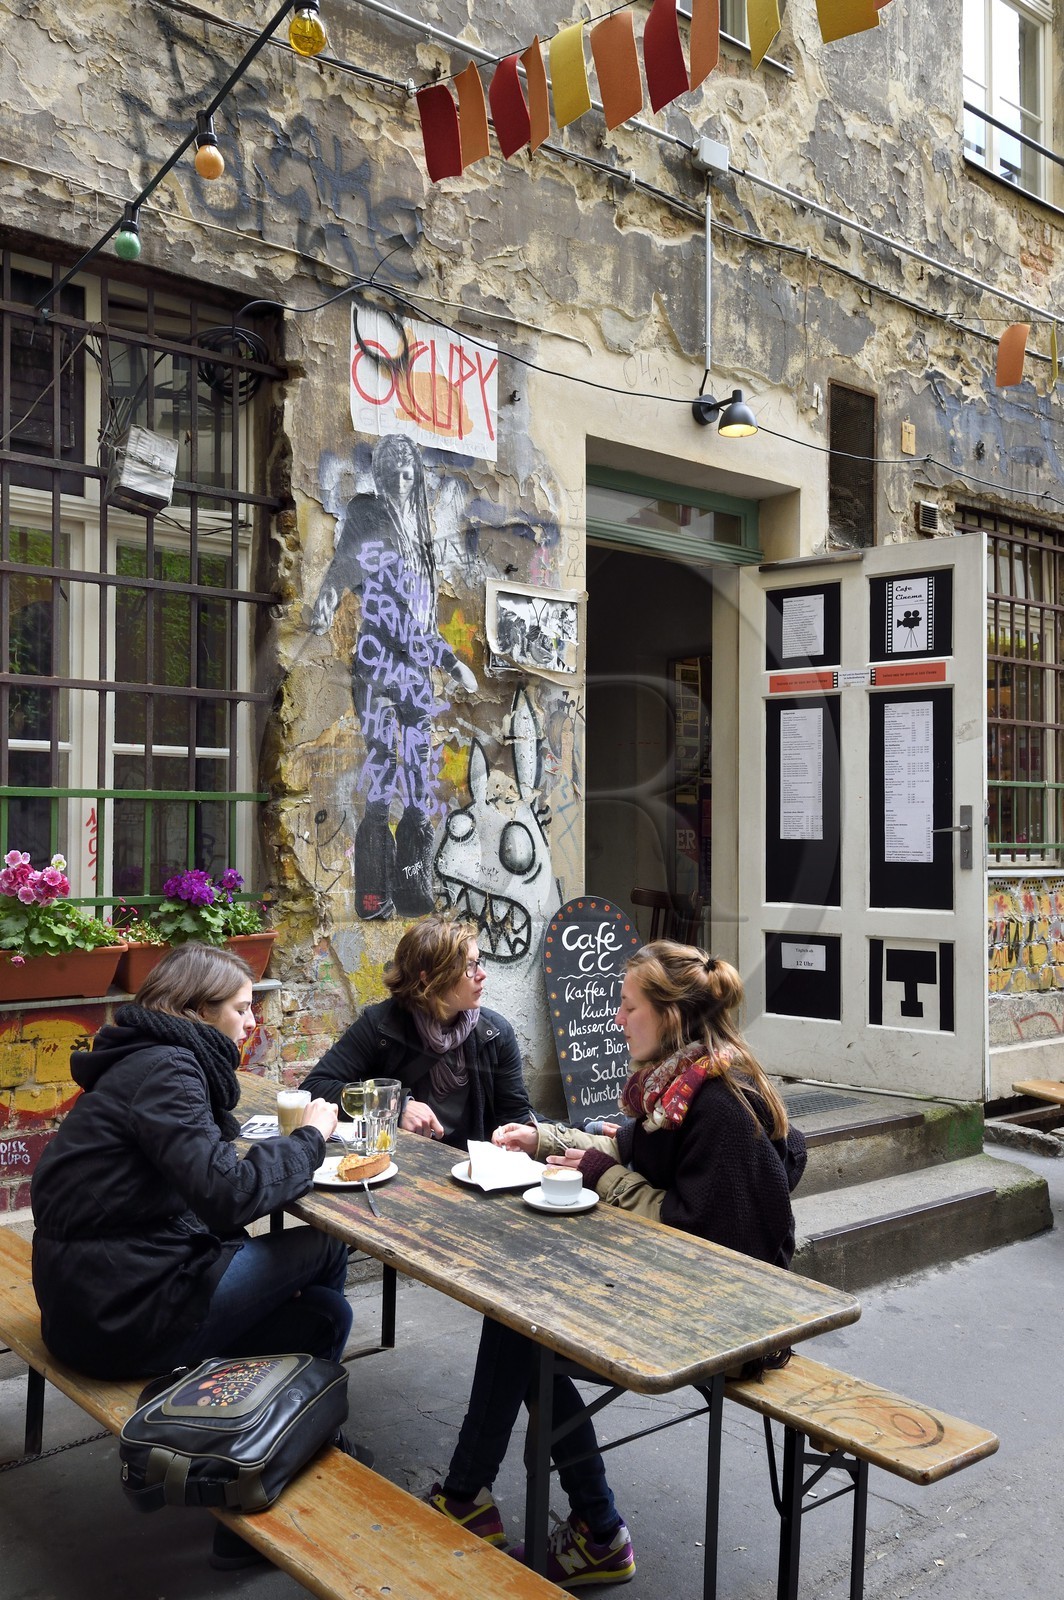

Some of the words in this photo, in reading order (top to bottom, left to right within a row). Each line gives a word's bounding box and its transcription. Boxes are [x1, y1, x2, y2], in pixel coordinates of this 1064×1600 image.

[562, 922, 623, 954] Café
[578, 951, 614, 972] CC
[565, 980, 607, 1005] Kaffee
[568, 1041, 599, 1061] Bier,
